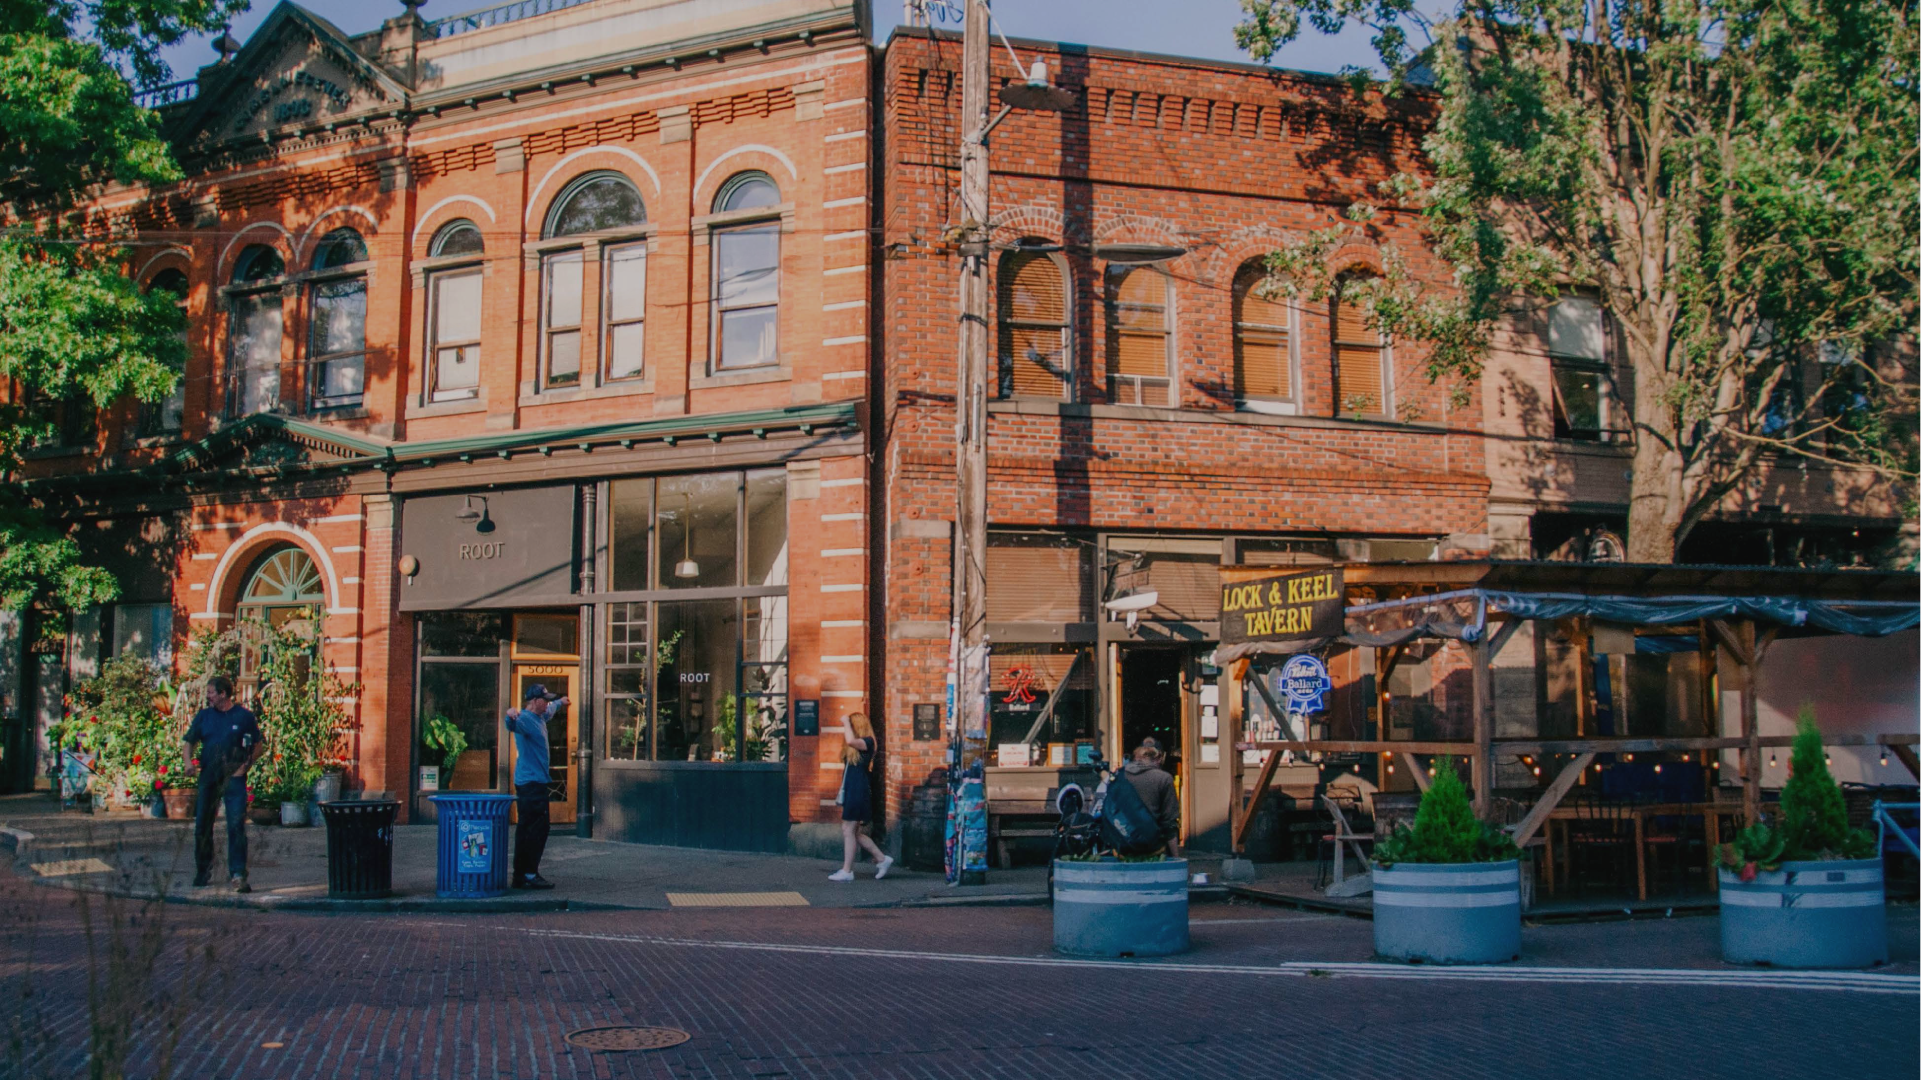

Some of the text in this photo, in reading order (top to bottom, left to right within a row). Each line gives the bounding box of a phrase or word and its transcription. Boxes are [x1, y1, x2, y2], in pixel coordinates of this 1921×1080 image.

[460, 542, 505, 560] ROOT
[1223, 574, 1339, 611] LOCK & KEEL
[1244, 606, 1313, 636] TAVERN
[528, 664, 564, 674] 5000
[680, 673, 710, 683] ROOT
[1287, 679, 1322, 689] Ballard
